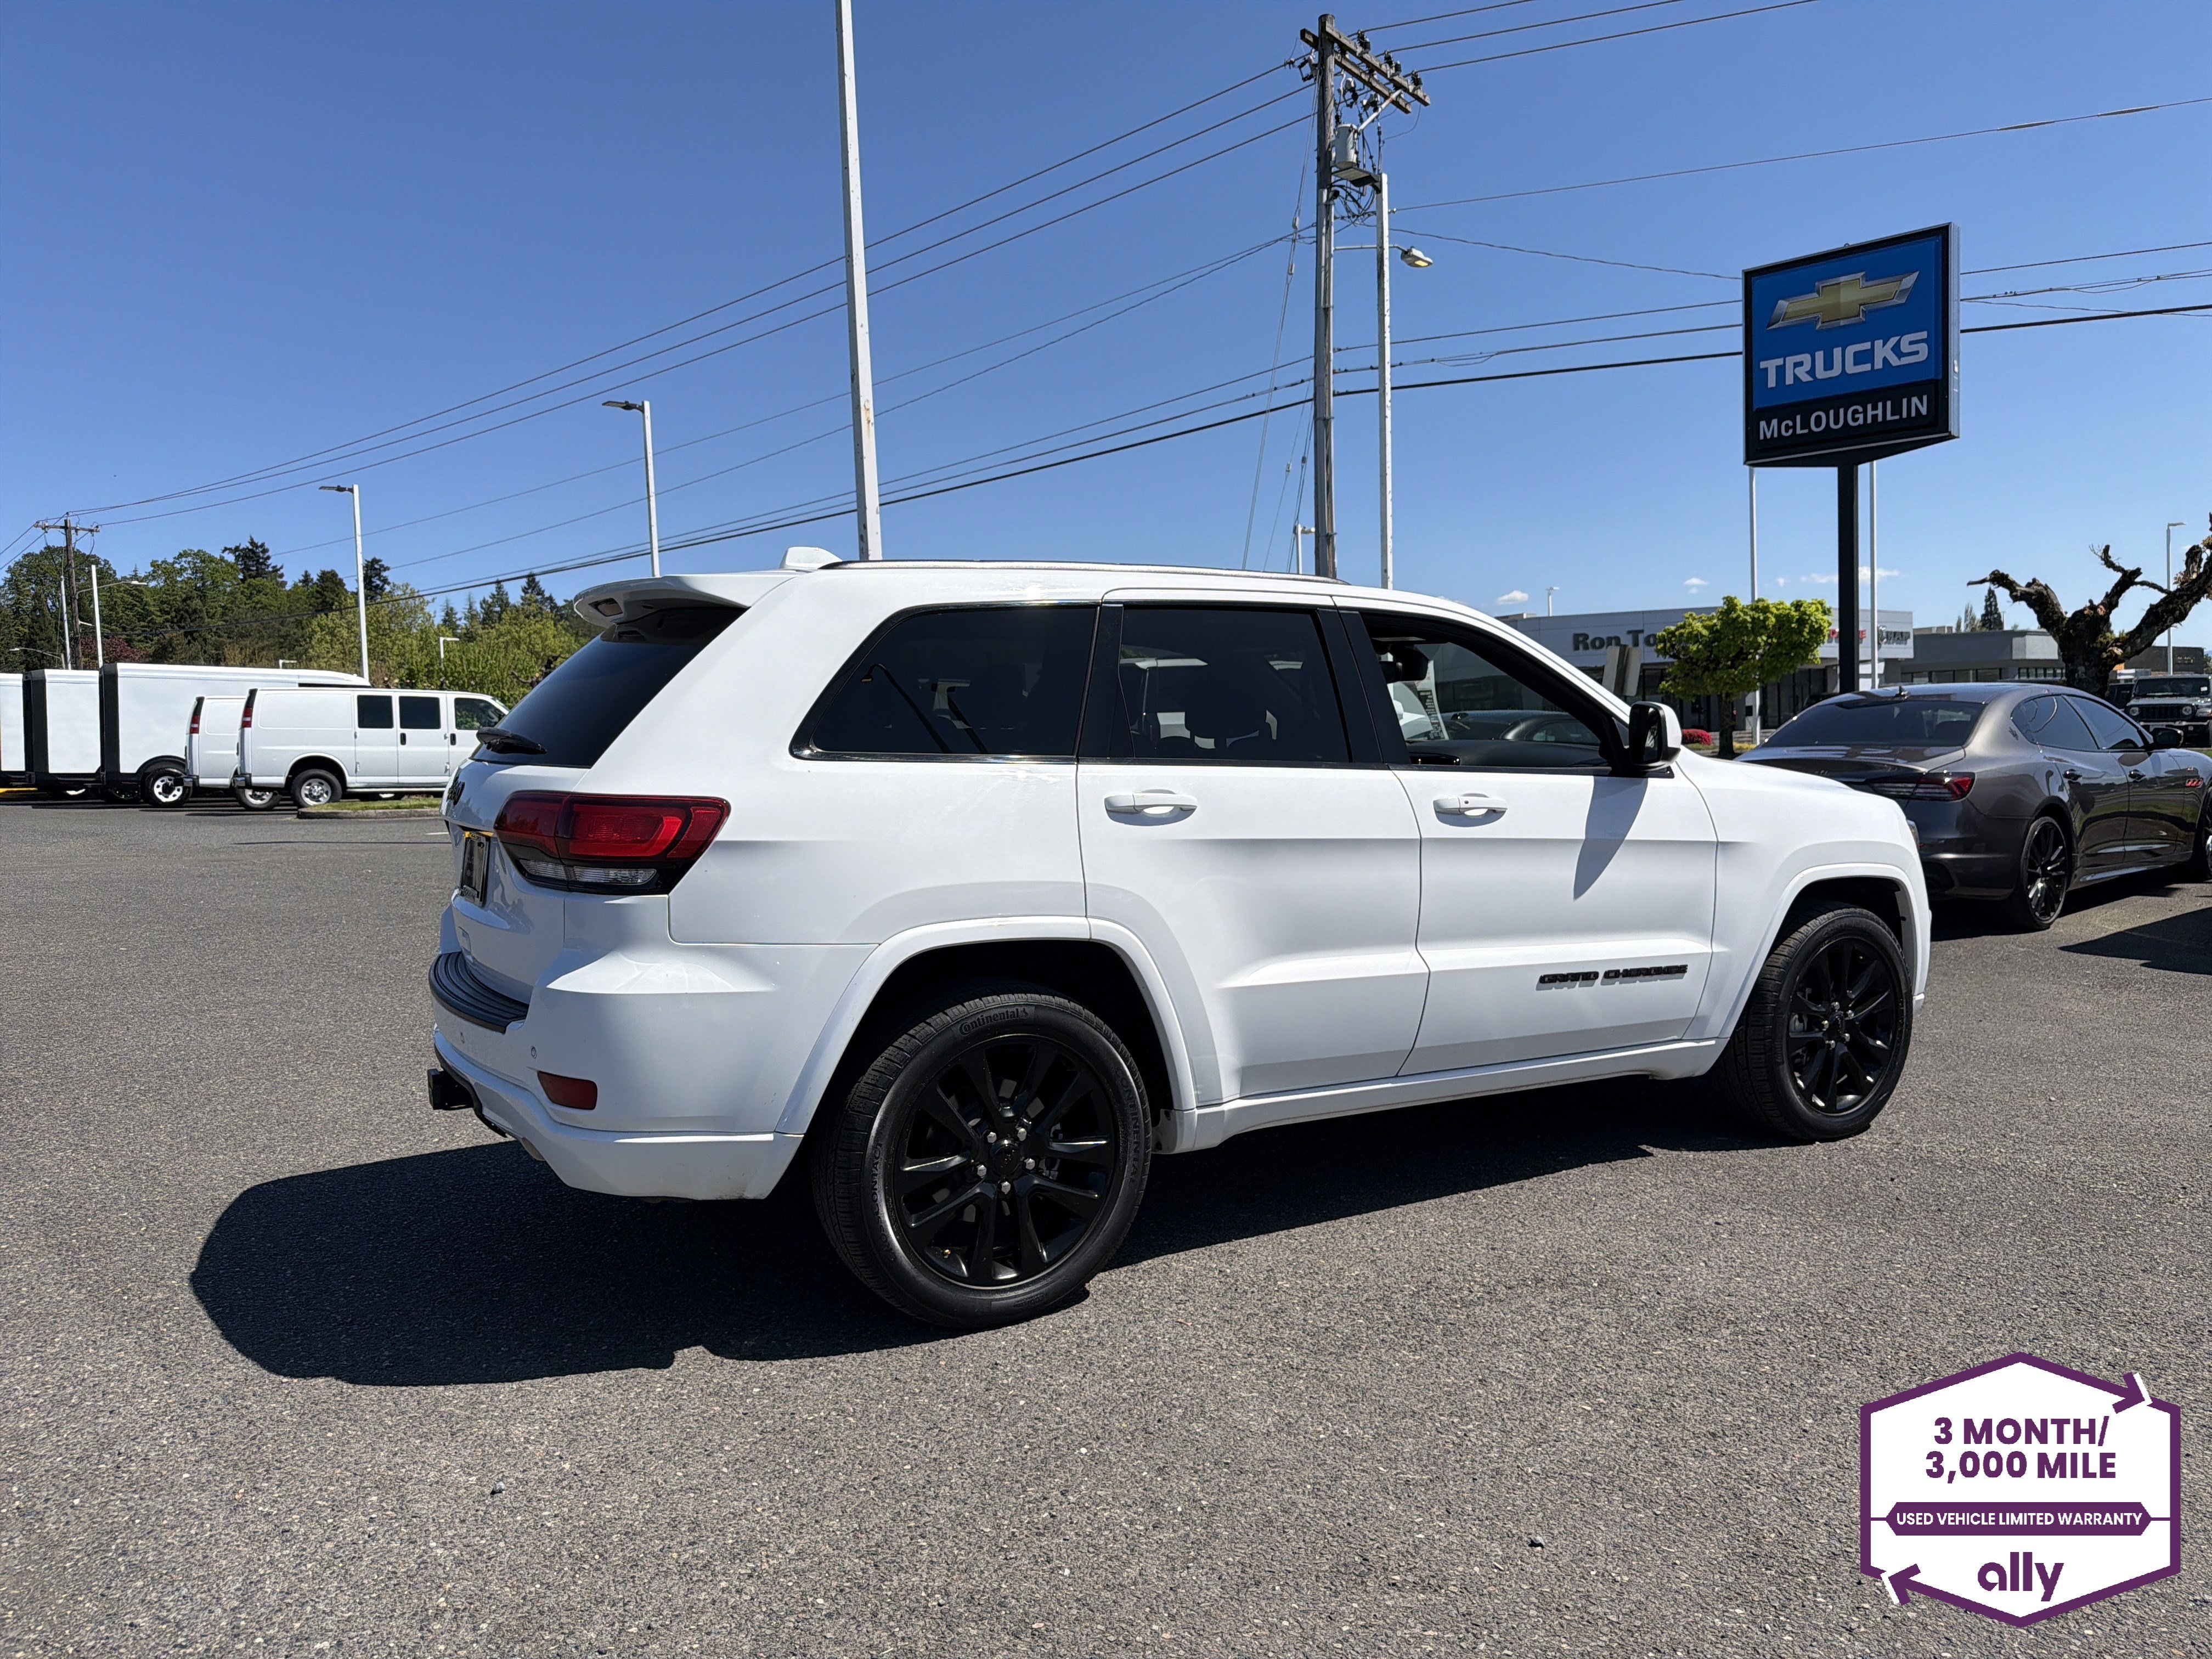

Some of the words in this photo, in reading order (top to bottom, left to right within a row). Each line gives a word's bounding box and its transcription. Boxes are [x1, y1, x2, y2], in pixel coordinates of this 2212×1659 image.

[1759, 331, 1928, 388] TRUCKS
[1759, 394, 1928, 440] McLOUGHLIN
[1573, 632, 1621, 651] Ron
[1627, 629, 1657, 647] To
[1539, 971, 1599, 984] GRAND
[1604, 964, 1688, 979] CHEROKEE
[959, 1008, 1019, 1036] Continental
